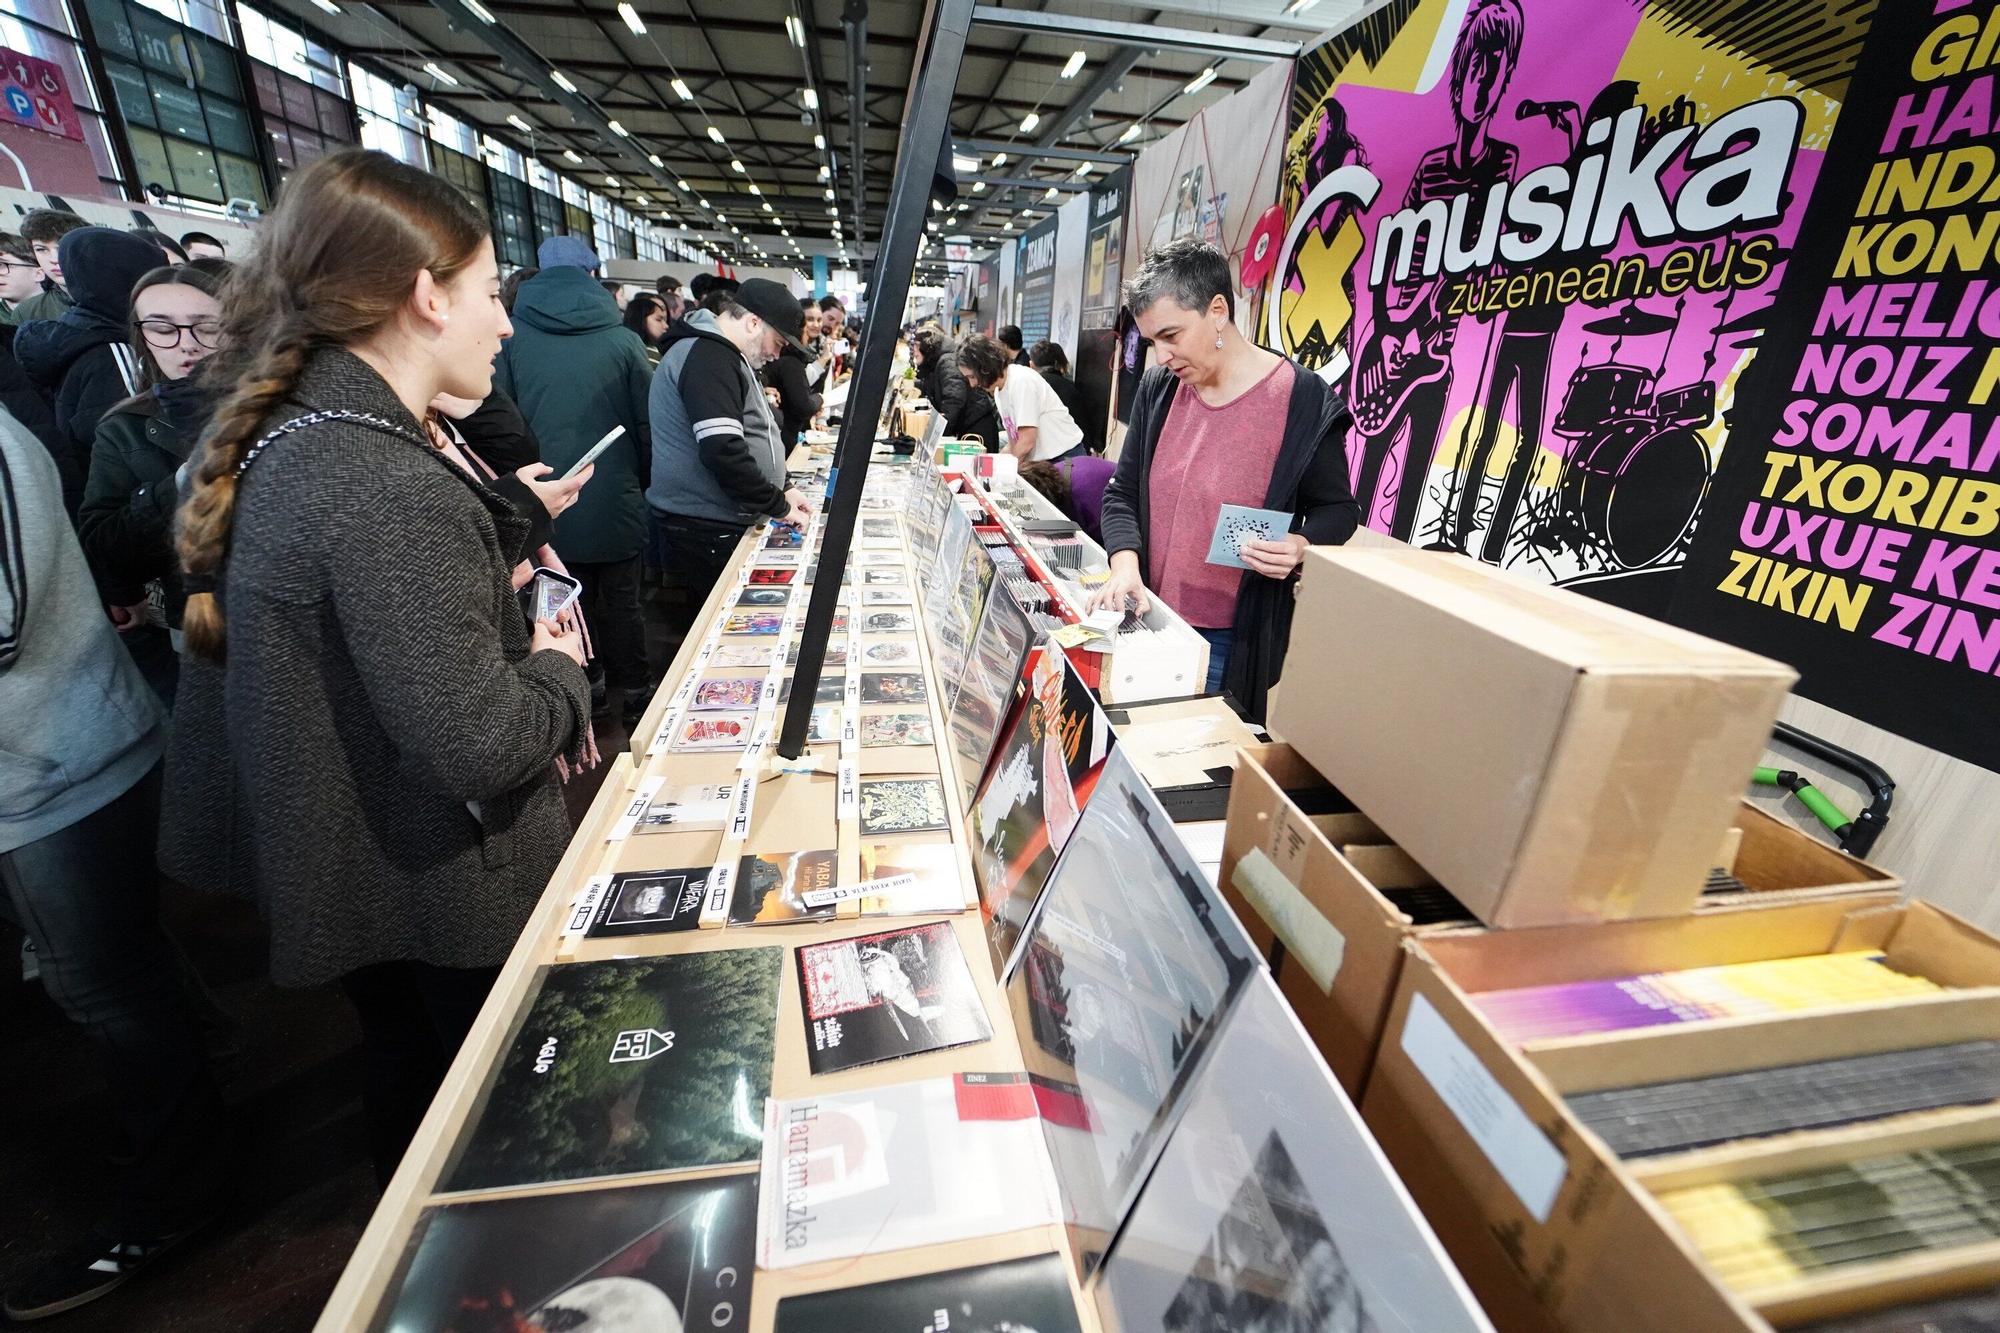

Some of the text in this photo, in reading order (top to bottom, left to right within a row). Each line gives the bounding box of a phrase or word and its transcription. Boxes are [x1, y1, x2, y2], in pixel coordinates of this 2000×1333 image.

[1911, 3, 2000, 82] GI
[1879, 75, 2000, 154] HA
[1370, 99, 1800, 286] musika
[1448, 239, 1773, 315] zuzenean.eus
[1832, 211, 2000, 278] KON
[1791, 344, 1974, 403] NOIZ
[1760, 451, 2000, 536] TXORIB
[1739, 501, 1913, 583] UXUE
[1716, 550, 2000, 678] ZIKIN ZIN
[716, 785, 732, 800] UR
[679, 880, 705, 914] VIAFARA
[785, 1094, 818, 1251] Harramazka
